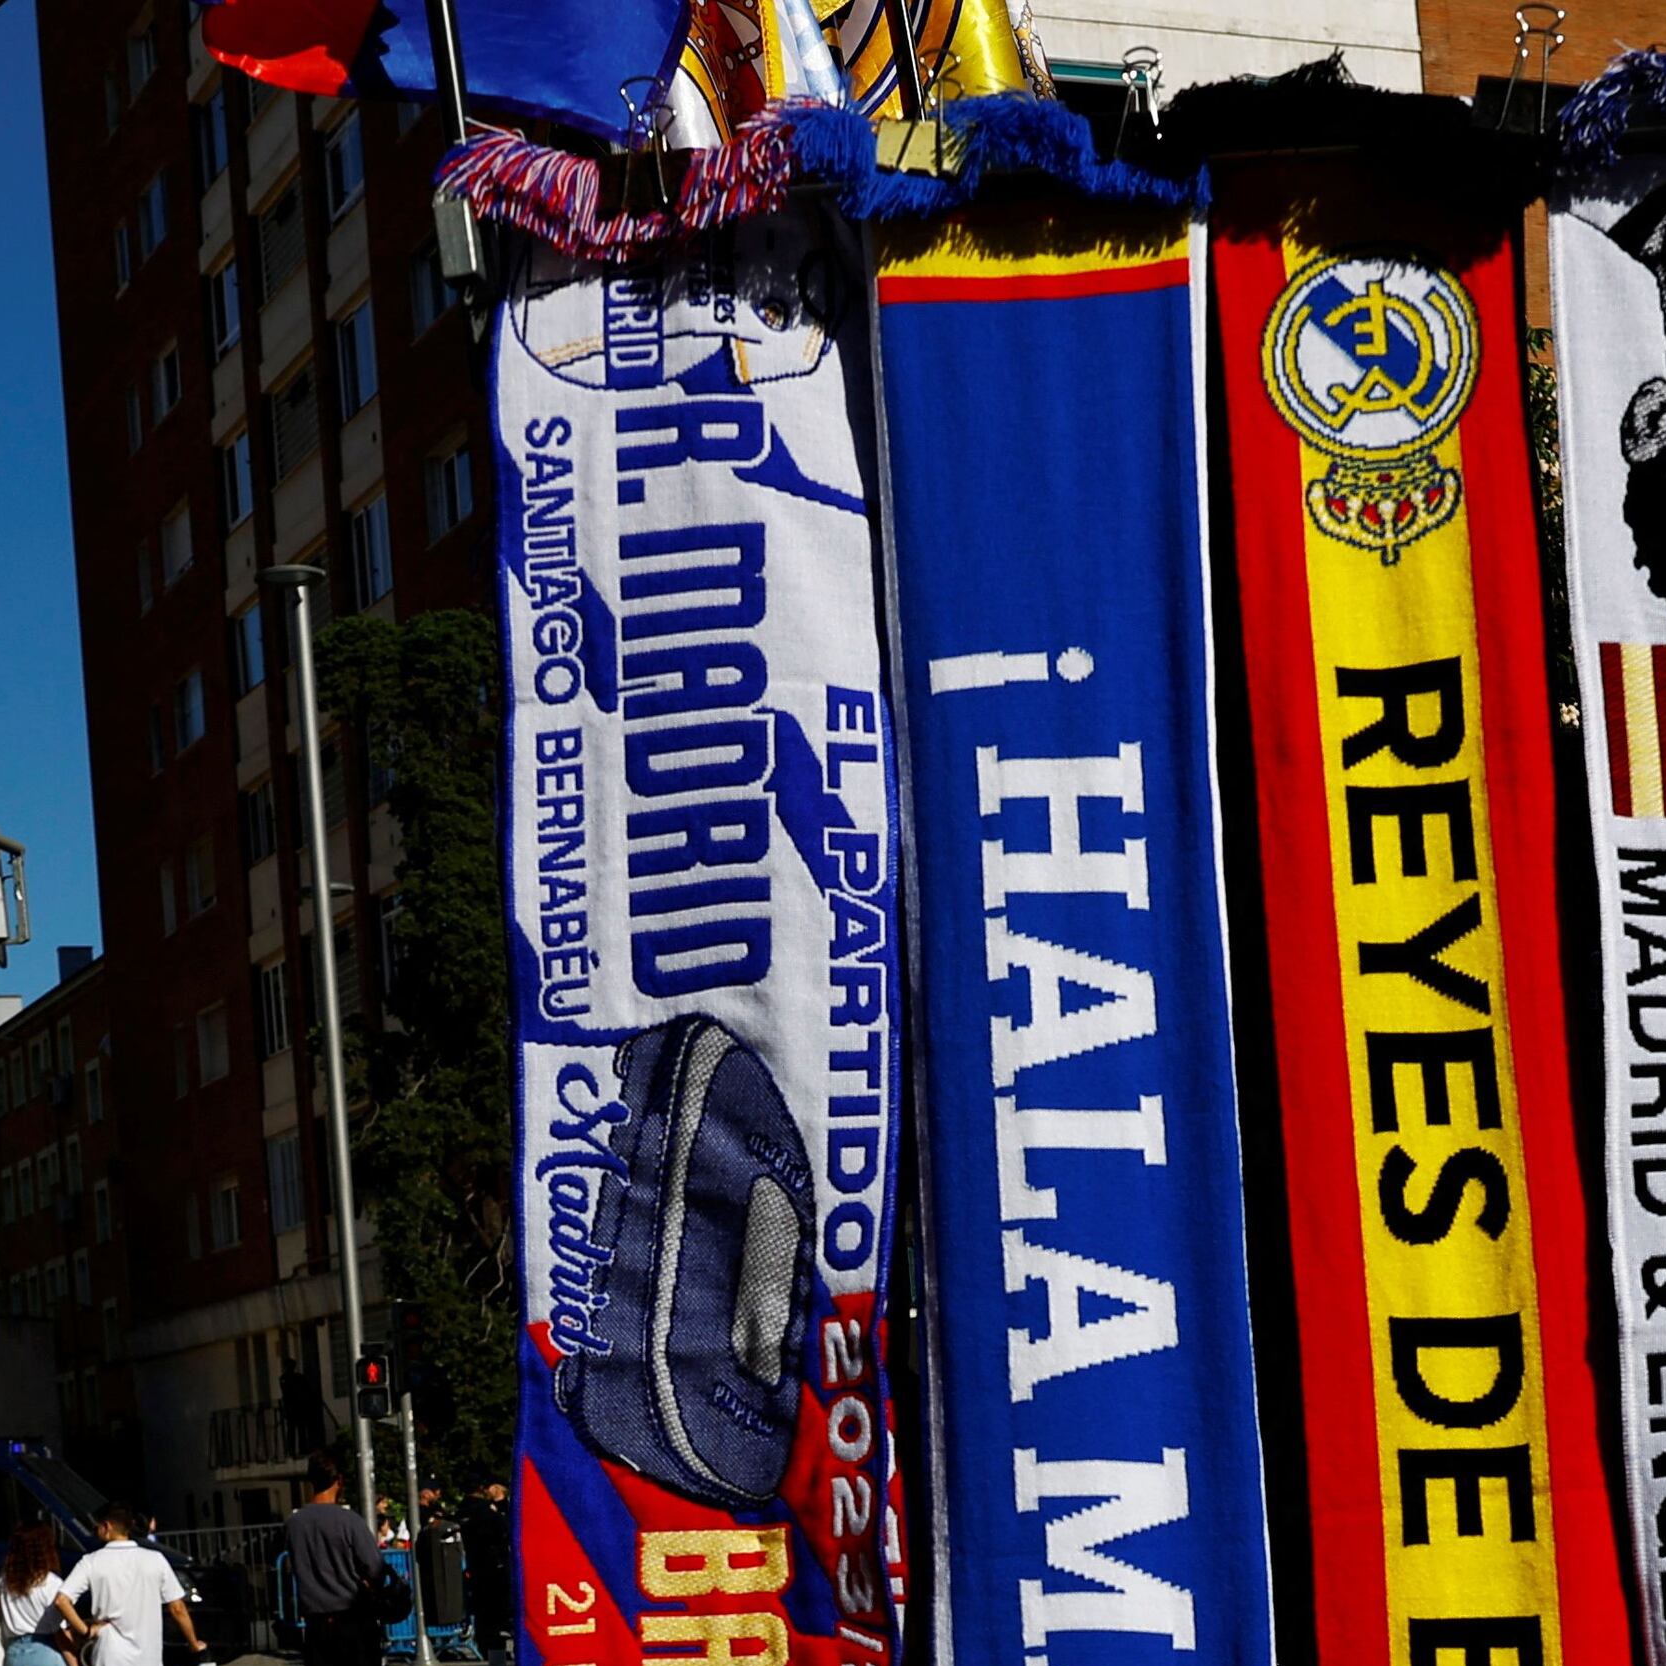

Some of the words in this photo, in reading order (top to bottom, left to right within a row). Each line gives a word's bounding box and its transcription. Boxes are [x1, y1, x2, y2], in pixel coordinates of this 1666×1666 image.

[523, 416, 584, 707] SANTIAGO
[825, 687, 876, 790] EL
[823, 828, 887, 1273] PARTIDO
[1335, 655, 1510, 1245] REYES
[1389, 1312, 1535, 1547] DE
[545, 1582, 596, 1638] 21
